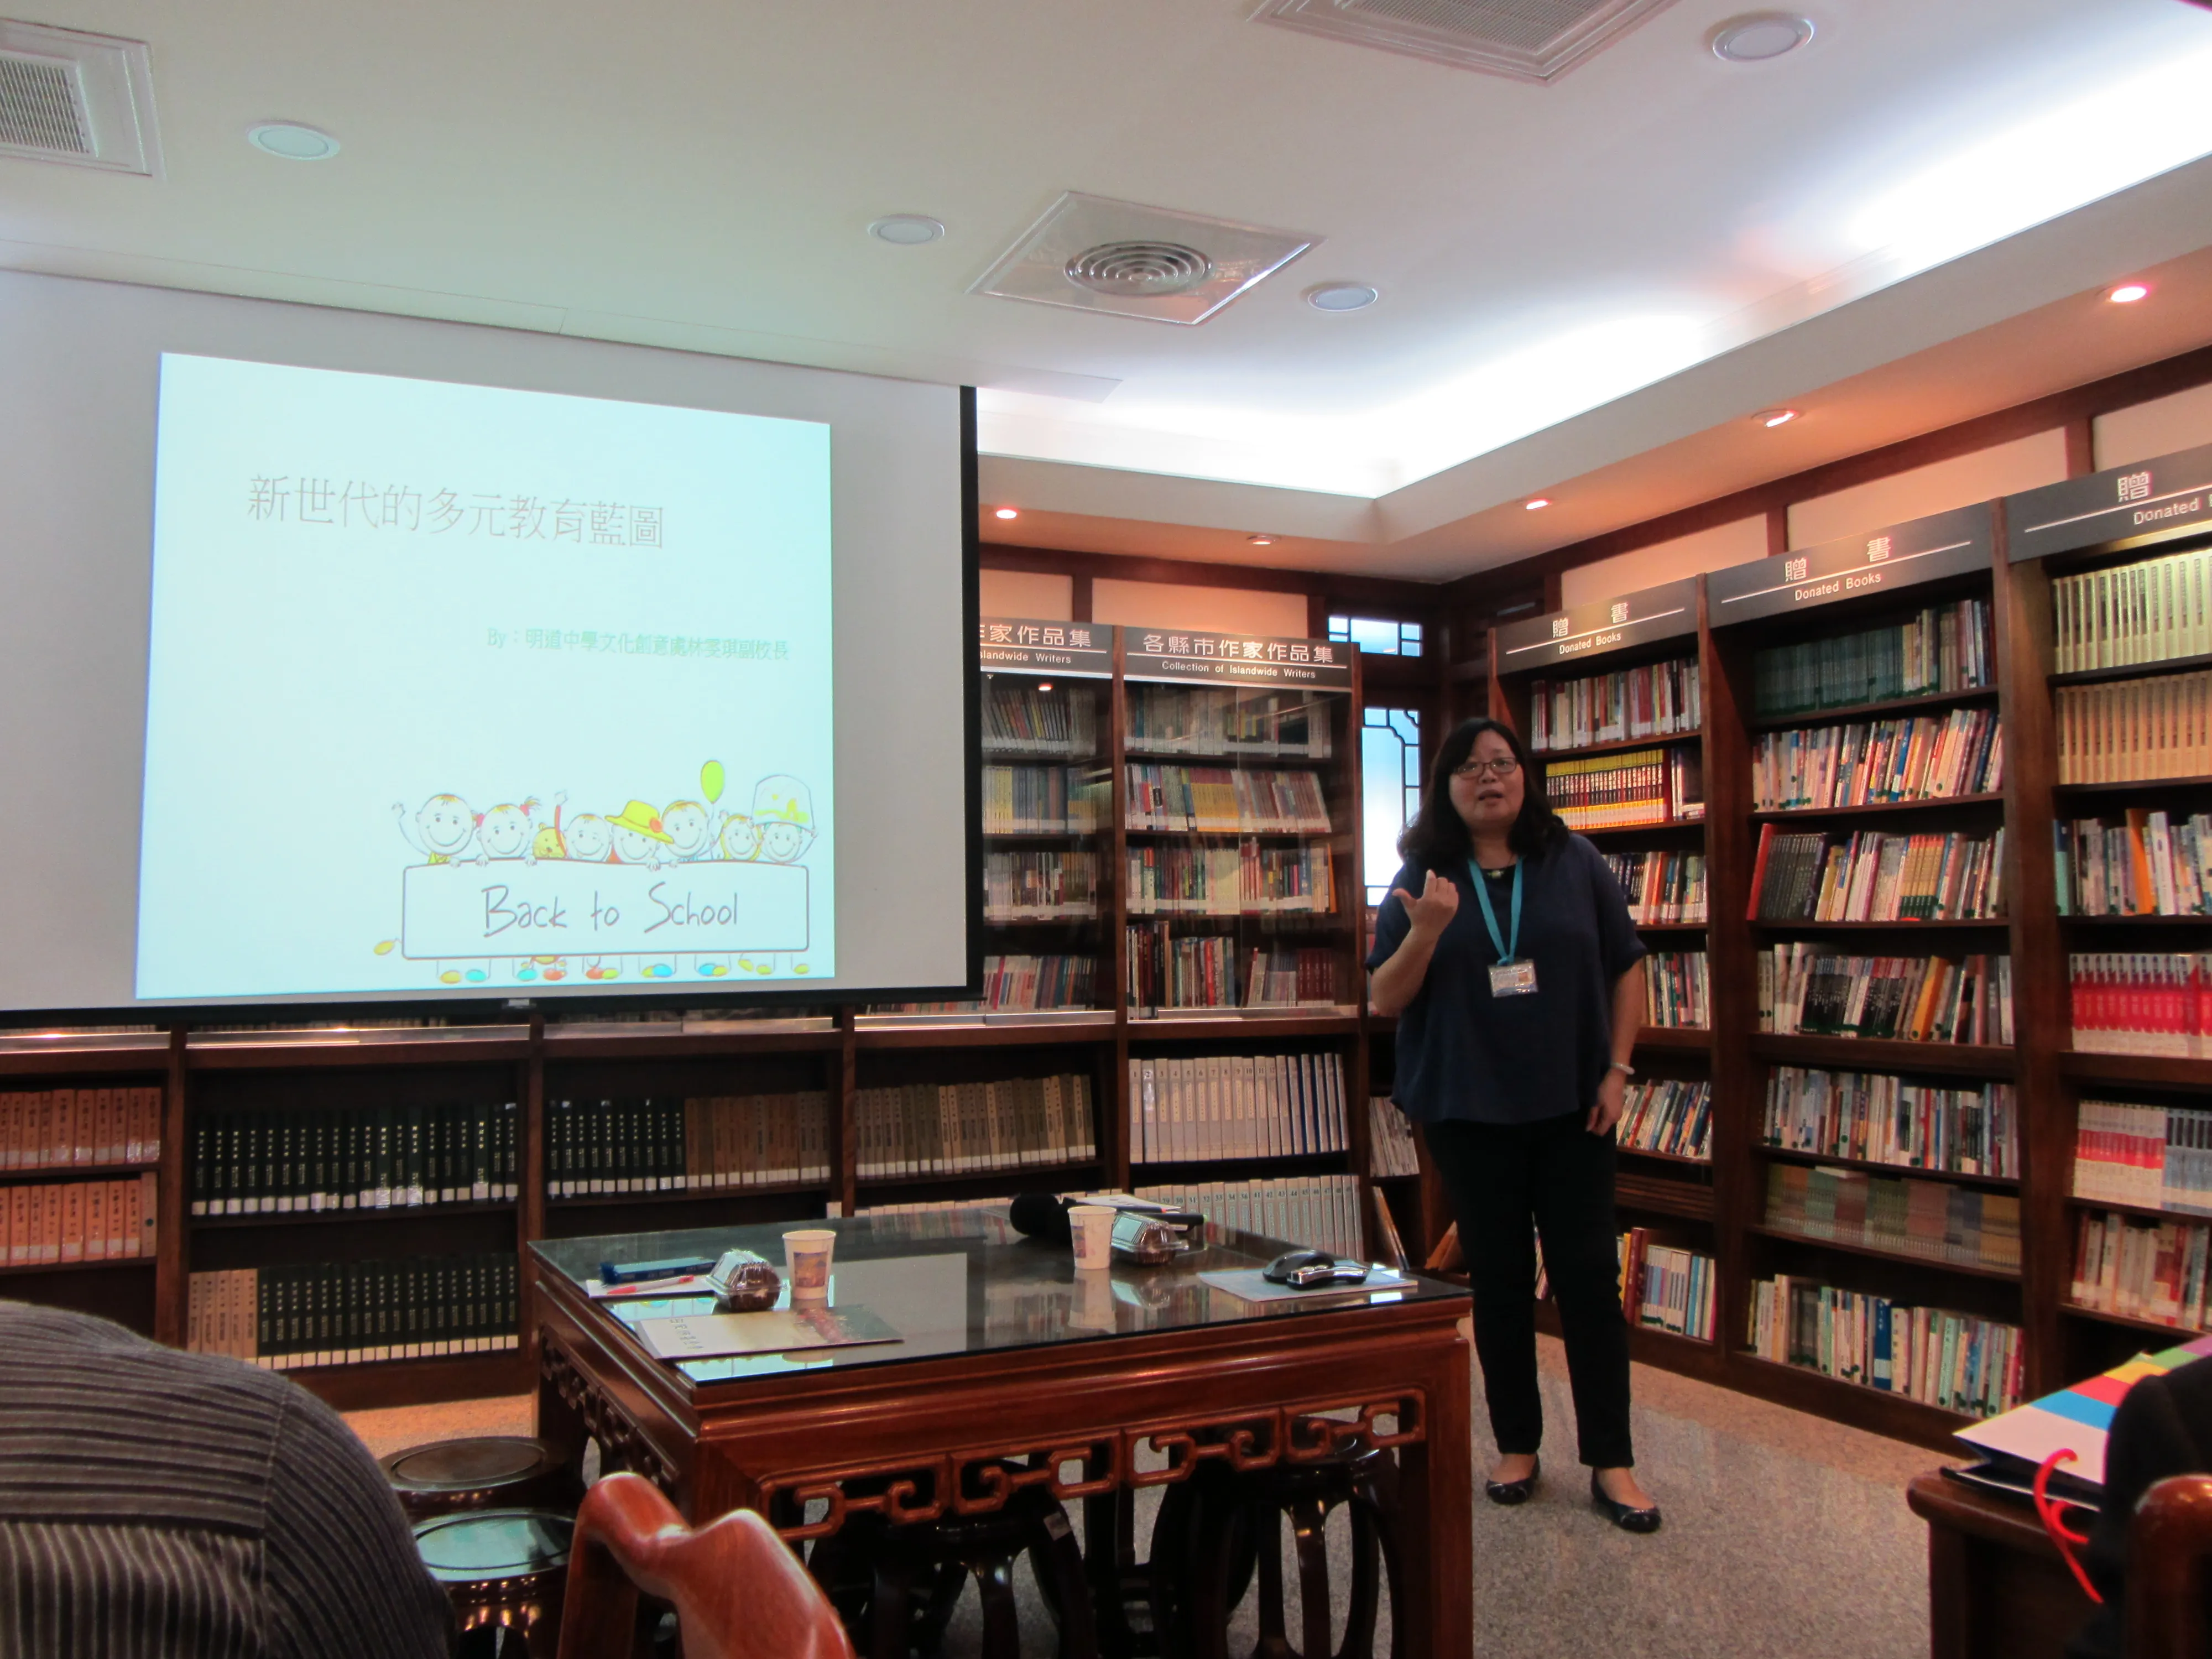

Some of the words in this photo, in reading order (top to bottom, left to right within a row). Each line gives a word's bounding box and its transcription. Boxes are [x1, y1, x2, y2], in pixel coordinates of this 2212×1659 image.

[2117, 471, 2150, 502] 贈
[247, 474, 664, 549] 新世代的多元教育藍圖
[2134, 498, 2199, 525] Donated
[1785, 557, 1808, 582] 贈
[1866, 536, 1891, 562] 書
[1794, 581, 1839, 601] Donated
[1846, 573, 1881, 590] Books
[1552, 617, 1569, 638] 贈
[1610, 602, 1628, 624] 書
[980, 651, 1029, 661] slandwide
[1036, 654, 1072, 664] Writers
[1143, 634, 1333, 663] 各縣市作家作品集
[1559, 639, 1592, 654] Donated
[1596, 633, 1621, 646] Books
[1162, 661, 1209, 673] Collection
[1215, 664, 1224, 673] of
[1229, 665, 1278, 677] Islandwide
[1284, 669, 1316, 679] Writers
[481, 885, 567, 937] Back
[591, 890, 619, 931] to
[644, 881, 738, 933] School
